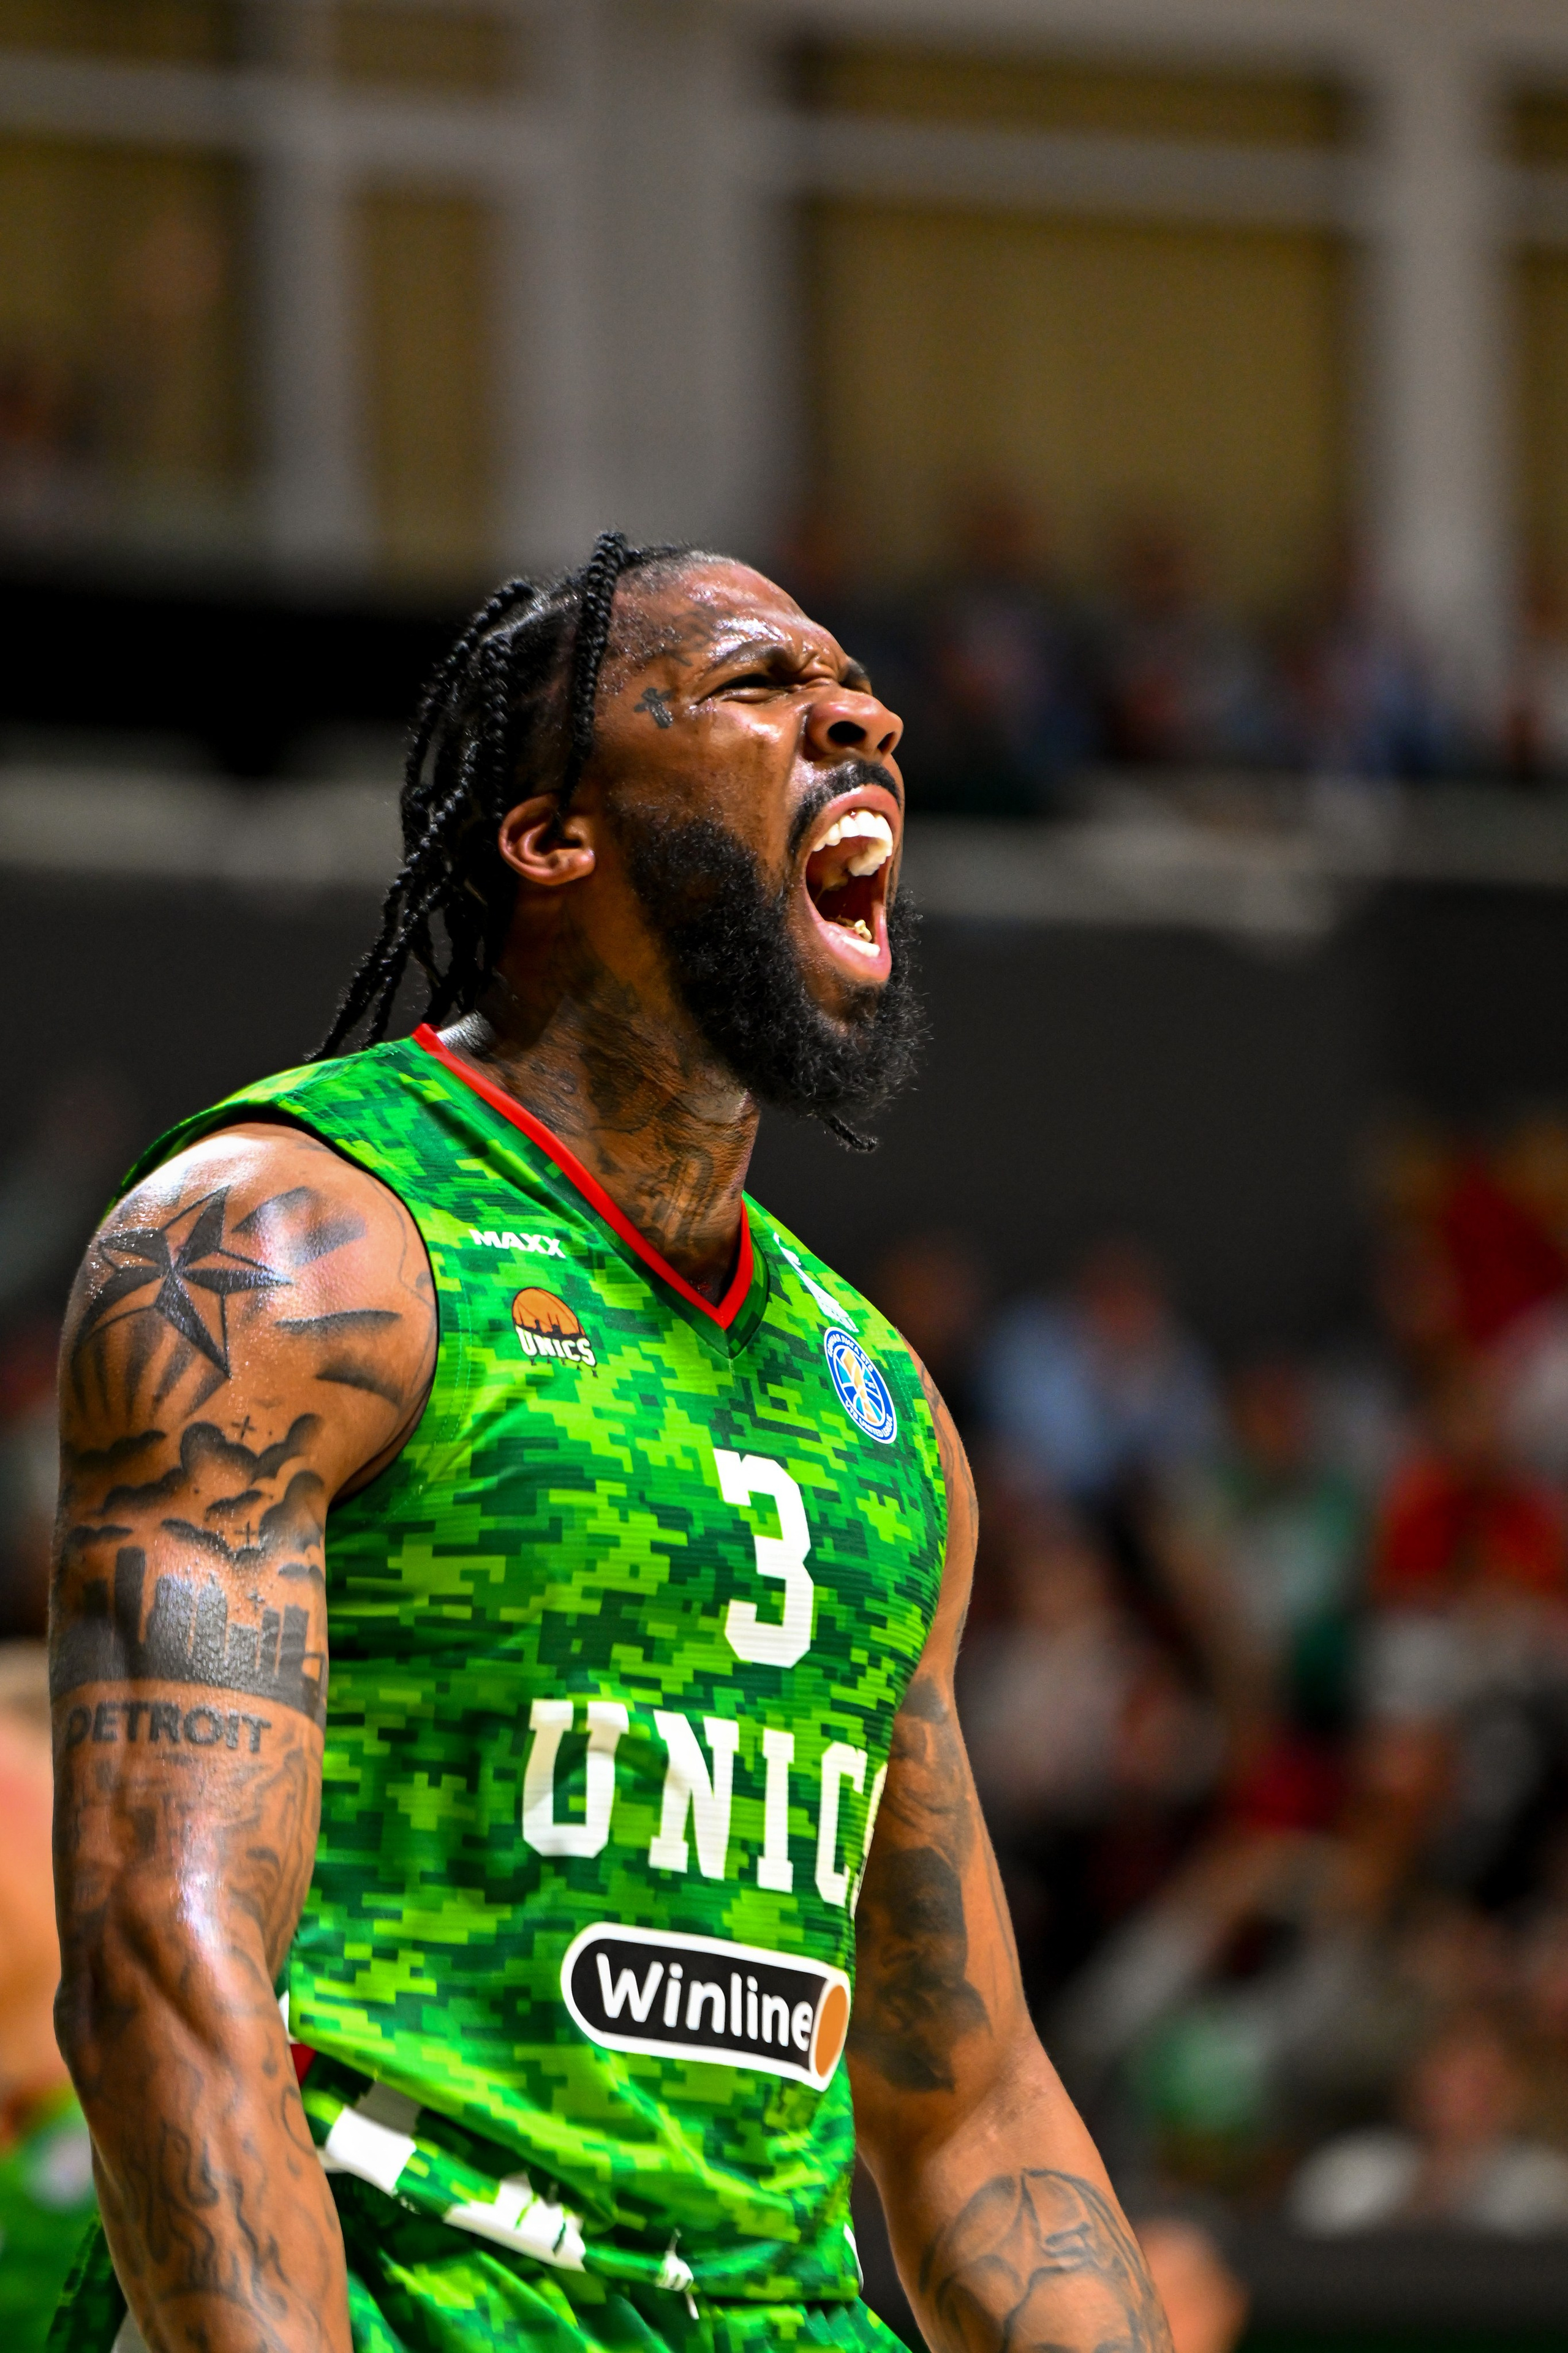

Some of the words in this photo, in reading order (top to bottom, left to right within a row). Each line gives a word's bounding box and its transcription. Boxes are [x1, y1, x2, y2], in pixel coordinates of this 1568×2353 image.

[469, 1229, 566, 1258] MAXX
[515, 1325, 596, 1366] UNICS
[713, 1448, 814, 1669] 3
[64, 1701, 271, 1753] DETROIT
[596, 1952, 813, 2052] Winline
